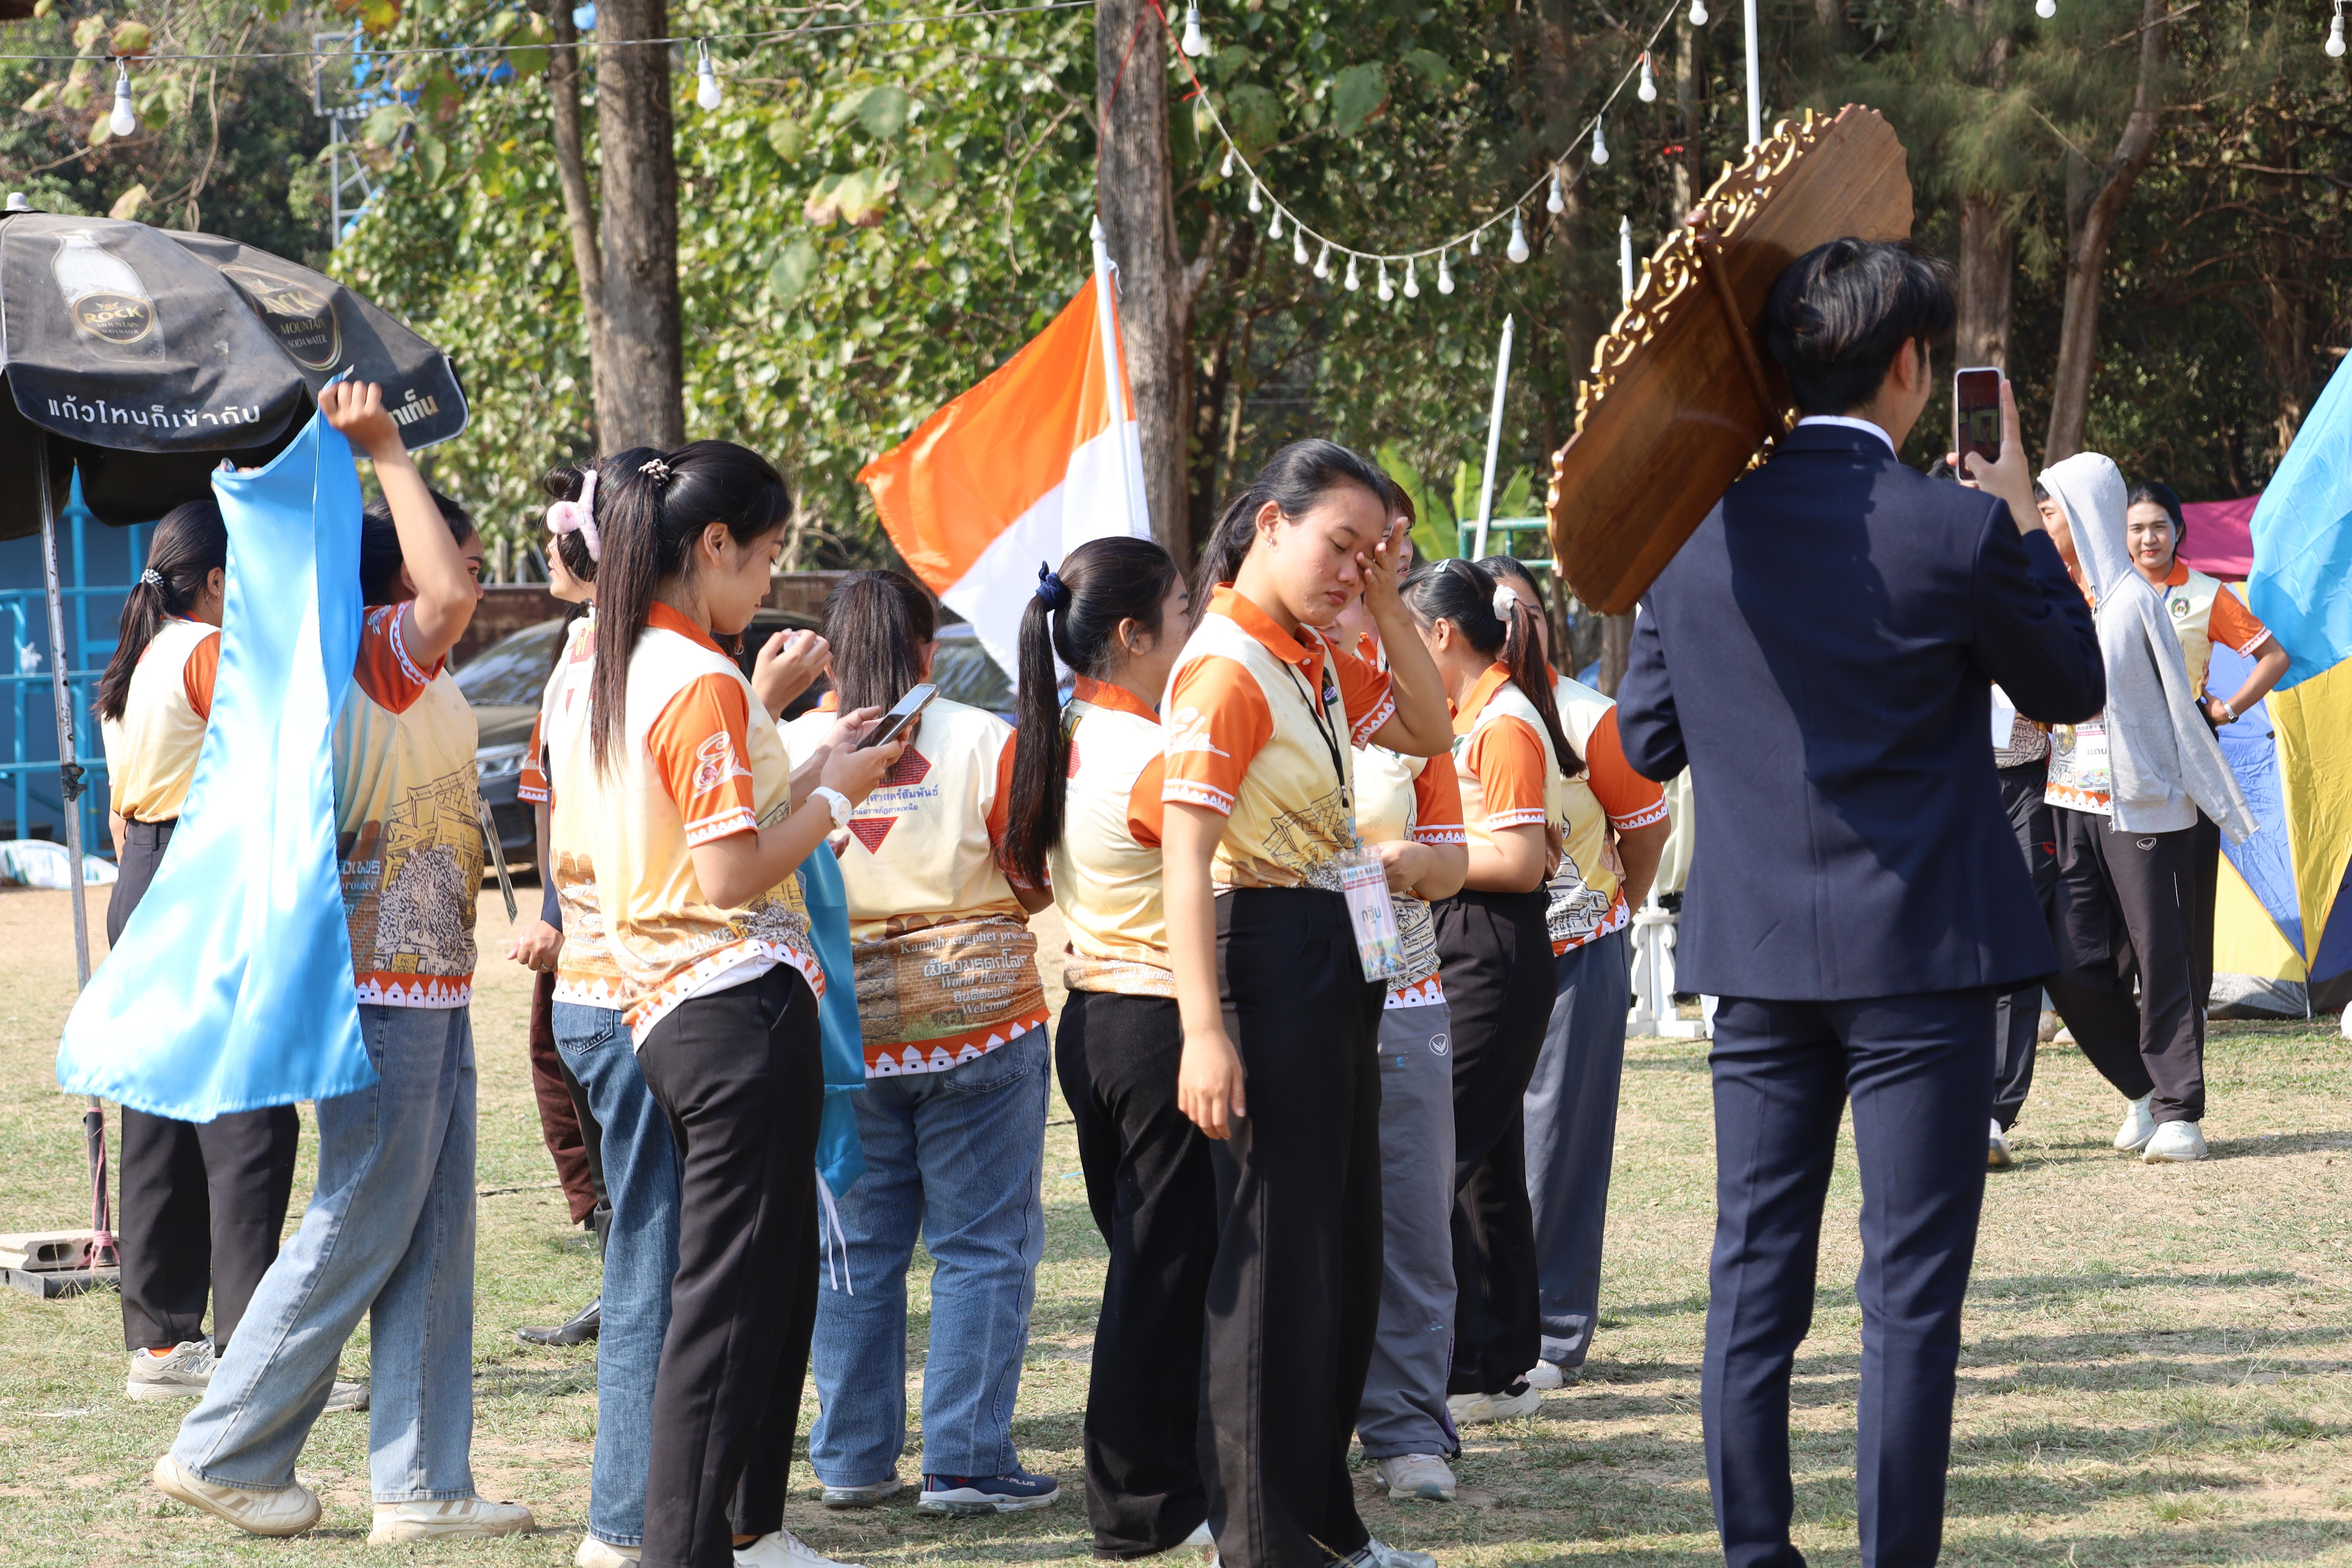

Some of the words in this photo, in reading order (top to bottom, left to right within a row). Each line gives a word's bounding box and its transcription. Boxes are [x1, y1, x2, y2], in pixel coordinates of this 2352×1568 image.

[83, 306, 145, 323] ROCK
[280, 318, 326, 335] MOUNTAIN
[900, 930, 997, 954] Kamphaengphet
[941, 972, 975, 990] World
[980, 970, 1018, 985] Heritage
[1140, 967, 1175, 983] Heritag
[961, 999, 1012, 1015] Welcome
